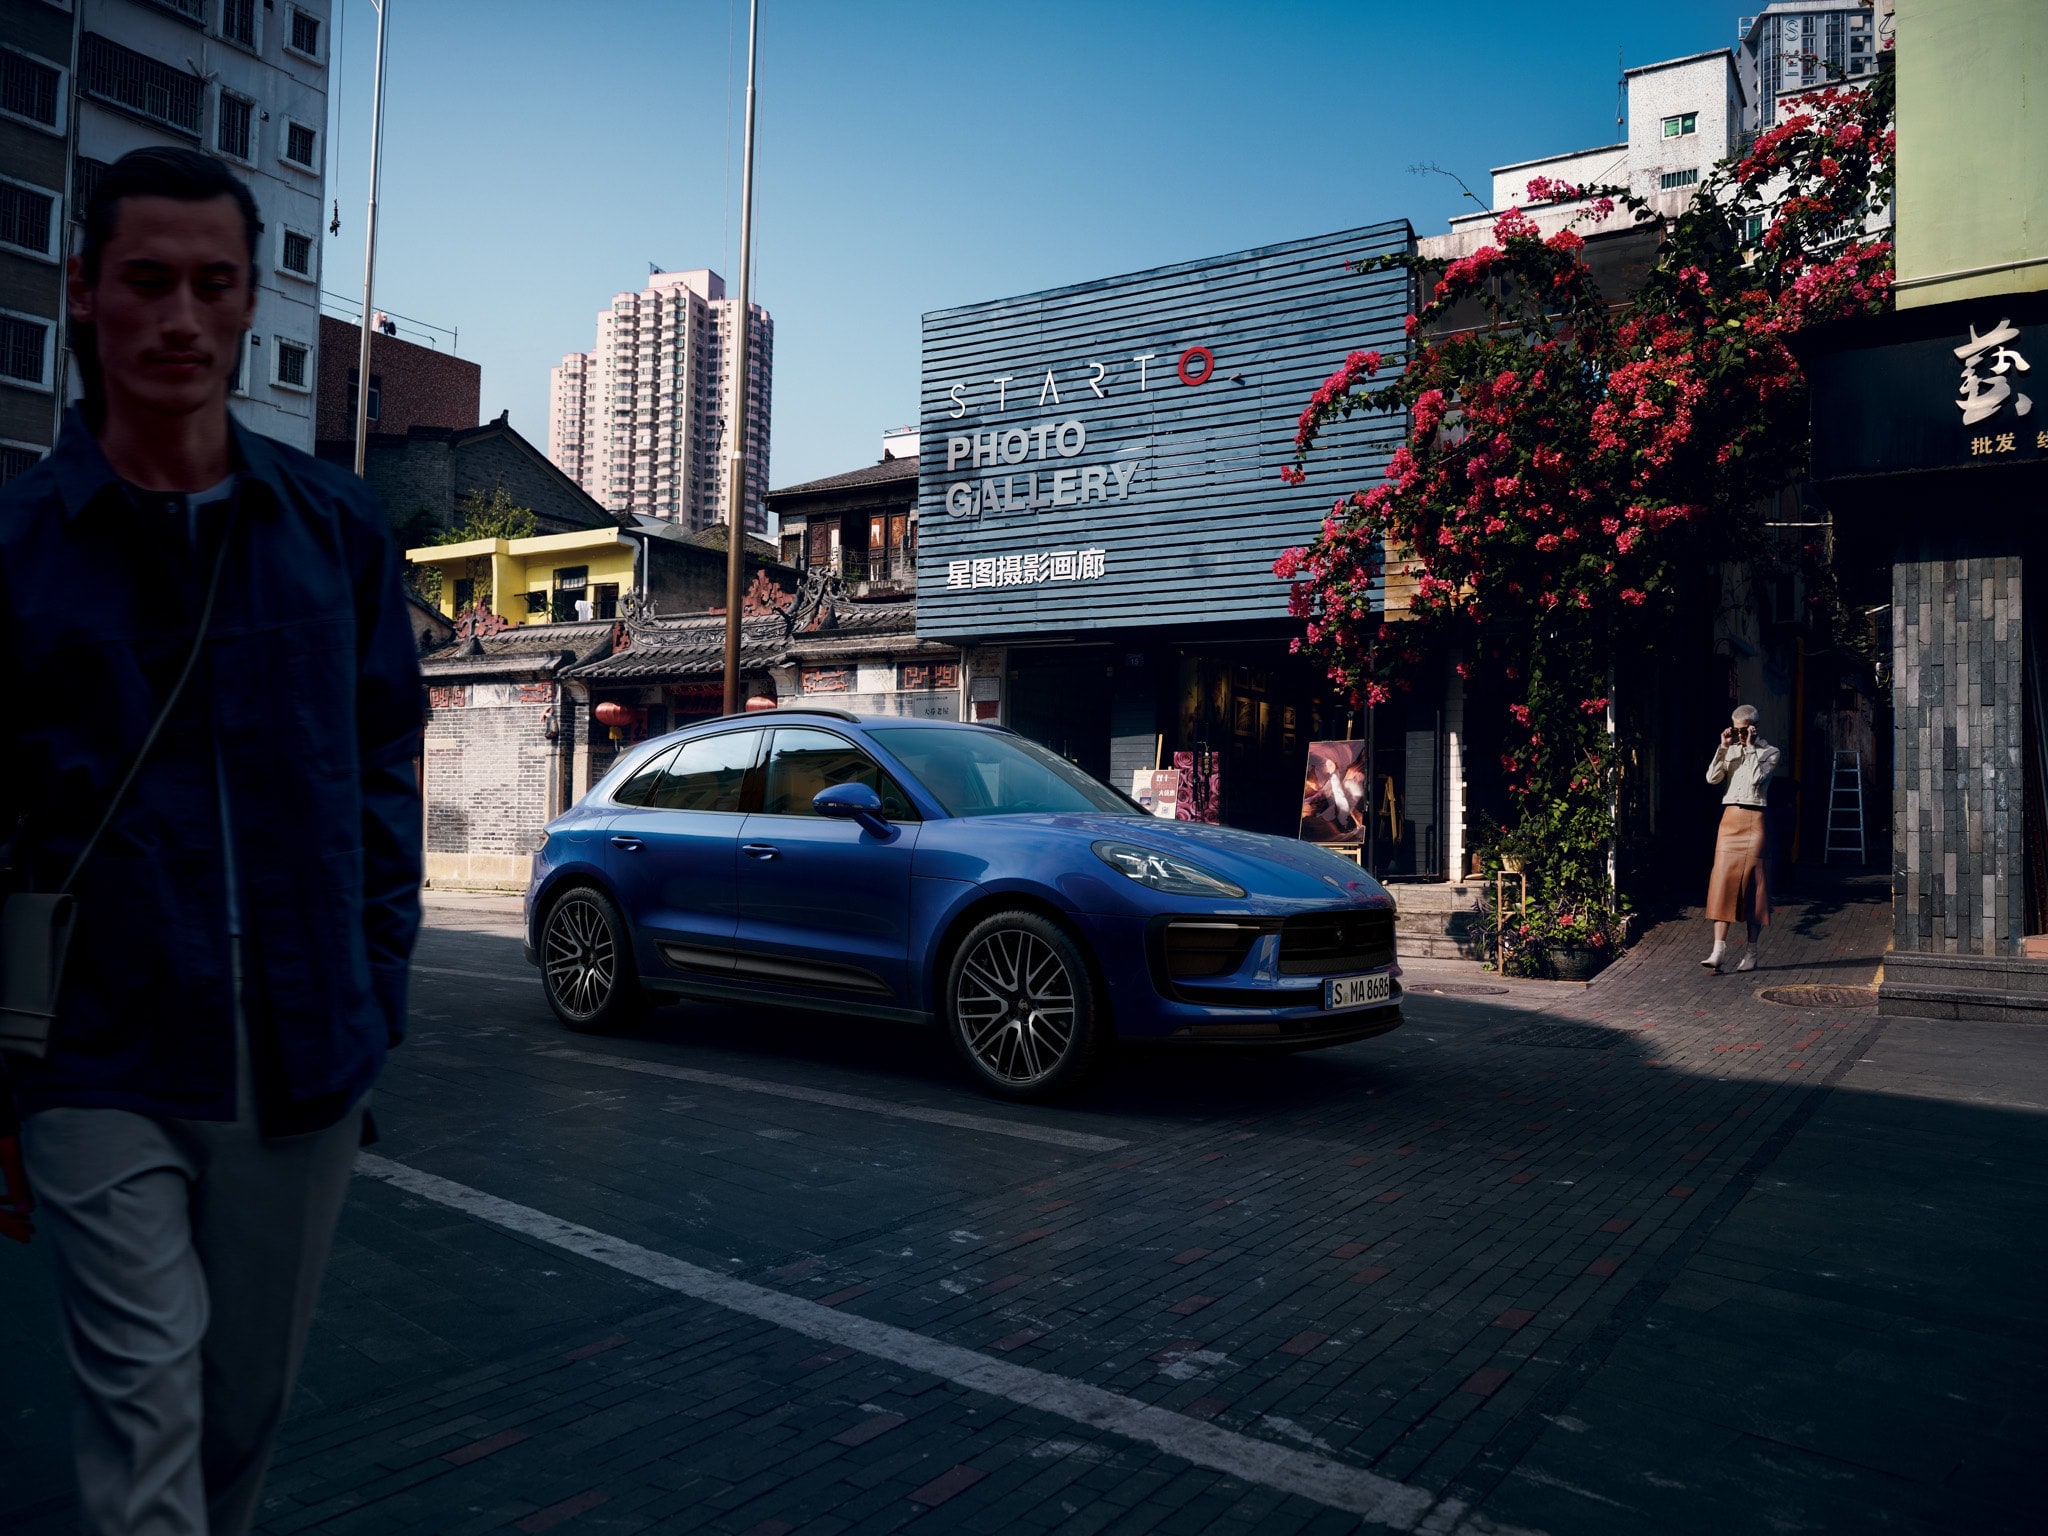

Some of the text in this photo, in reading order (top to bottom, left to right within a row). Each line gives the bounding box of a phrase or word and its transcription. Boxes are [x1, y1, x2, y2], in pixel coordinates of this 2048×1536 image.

[946, 420, 1086, 471] PHOTO
[1971, 432, 2016, 455] 批发
[945, 461, 1140, 518] GALLERY
[946, 547, 1106, 592] 星图摄影画廊
